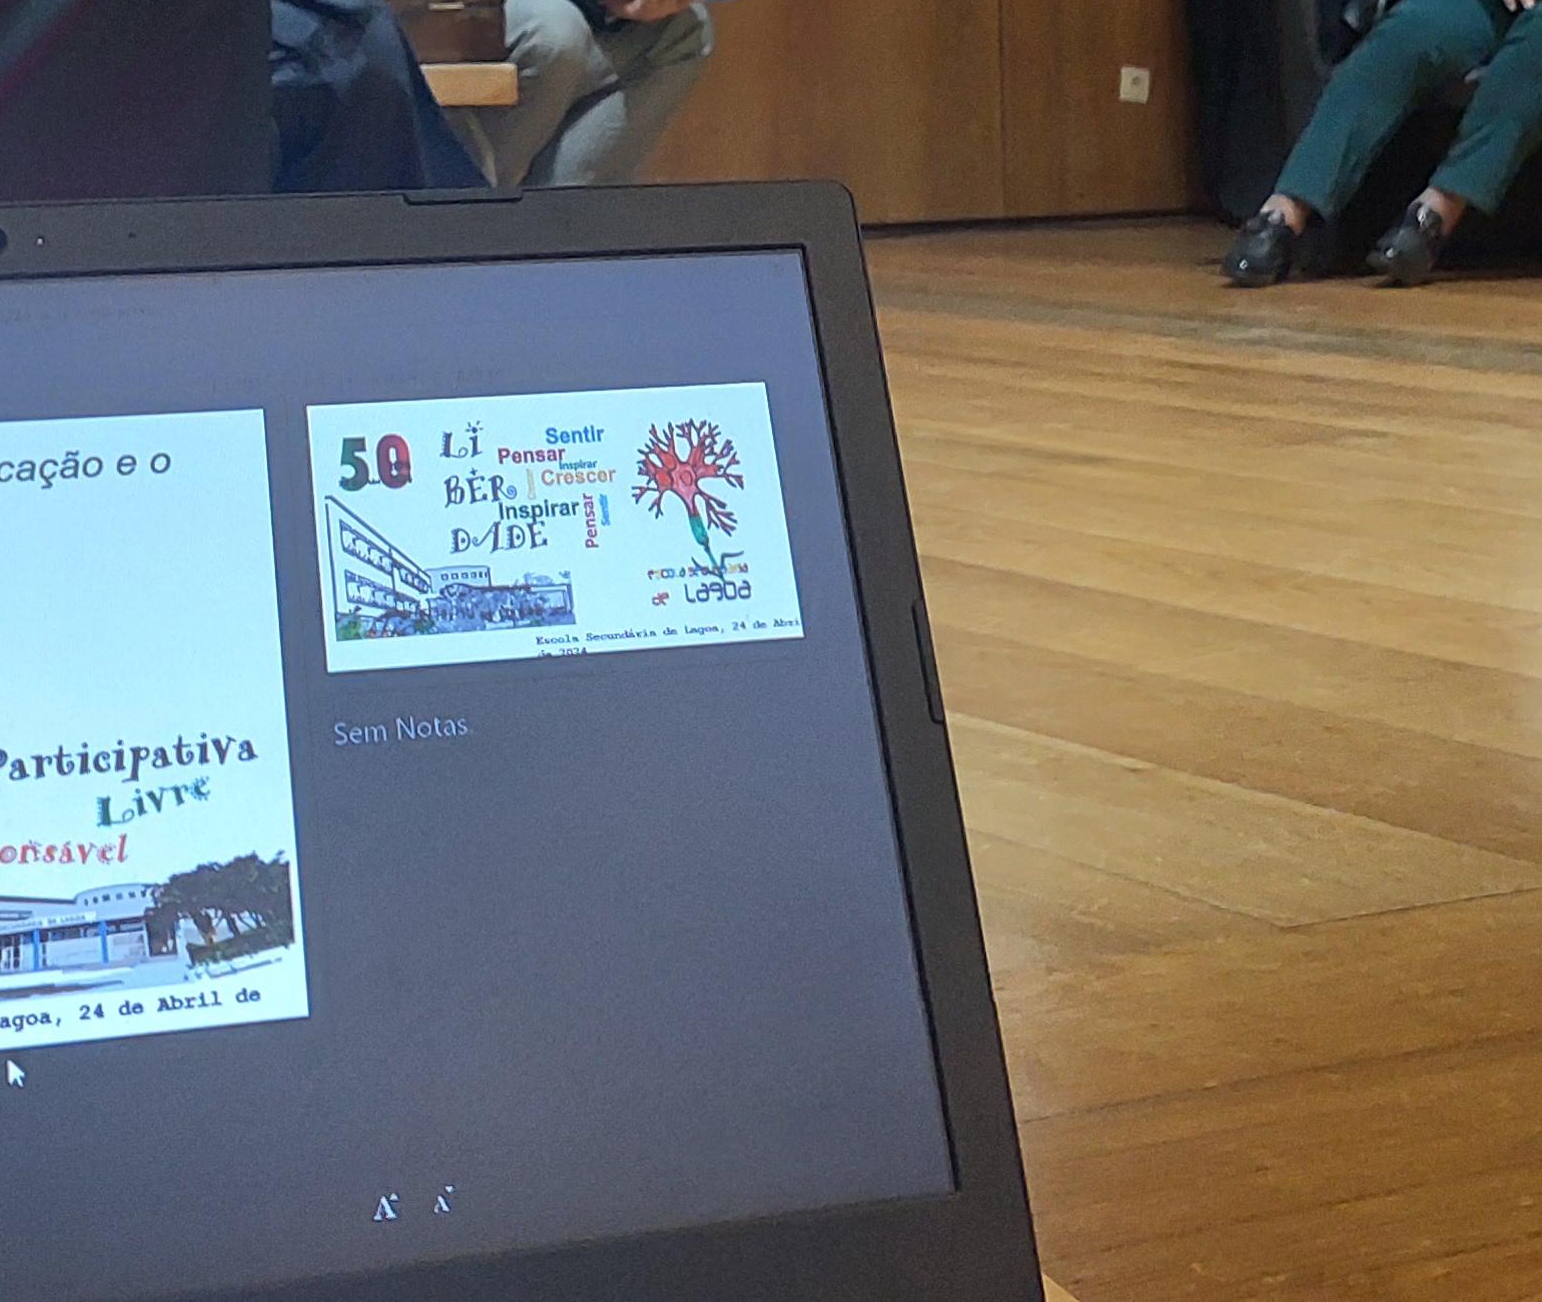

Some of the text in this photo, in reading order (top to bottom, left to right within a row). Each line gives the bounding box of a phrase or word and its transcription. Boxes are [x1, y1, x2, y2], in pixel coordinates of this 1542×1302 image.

[545, 425, 605, 445] Sentir
[116, 455, 137, 476] e
[150, 453, 171, 474] o
[338, 434, 411, 492] 50
[498, 447, 566, 464] Pensar
[541, 468, 616, 486] Crescer
[499, 499, 579, 525] Inspirar
[583, 493, 600, 549] Pensar
[536, 616, 802, 645] Escola Secundária de Lagoa, 24 de Abri
[334, 715, 469, 746] Sem Notas
[95, 775, 211, 828] Livre
[79, 1003, 104, 1020] 24
[119, 1000, 144, 1016] de
[157, 991, 222, 1012] Abril
[236, 988, 261, 1003] de
